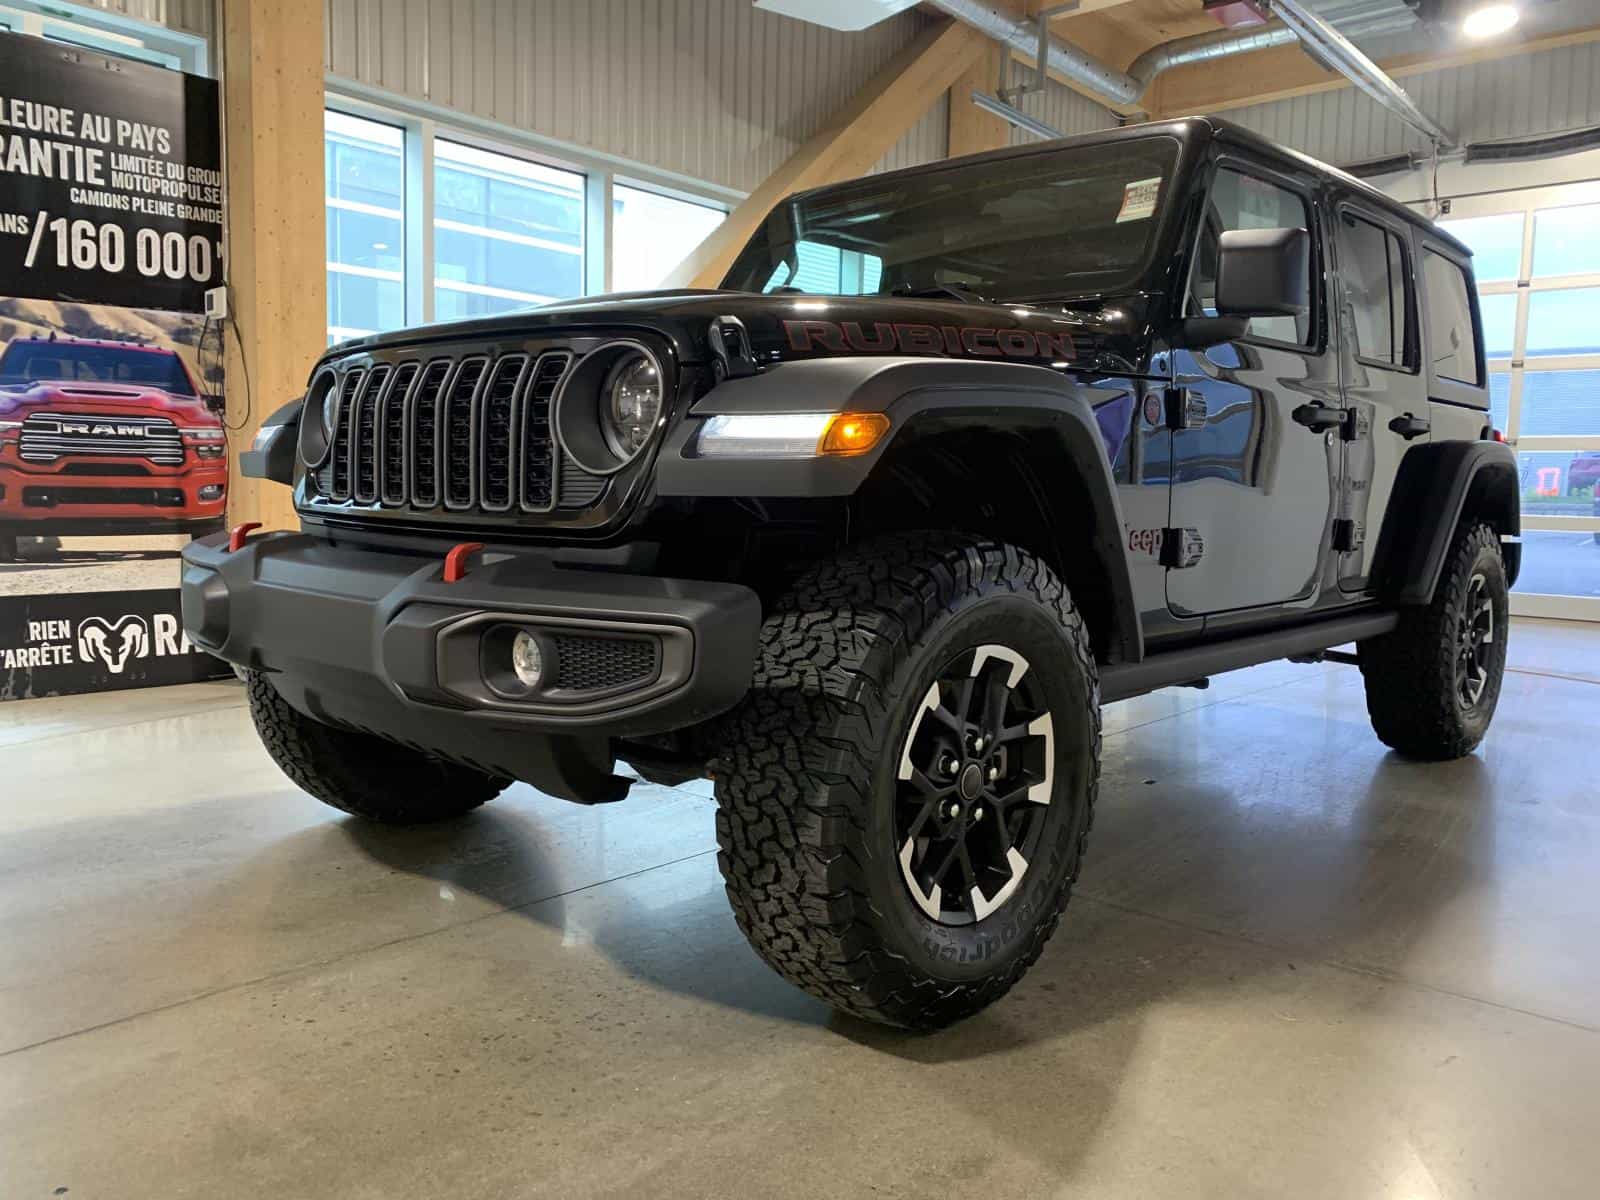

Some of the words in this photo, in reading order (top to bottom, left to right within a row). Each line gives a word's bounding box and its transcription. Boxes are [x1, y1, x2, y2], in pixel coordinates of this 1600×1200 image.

[80, 113, 111, 144] AU
[117, 120, 171, 155] PAYS
[0, 133, 105, 186] ANTIE
[110, 151, 164, 177] LIMITÉE
[166, 162, 185, 180] DU
[70, 187, 130, 211] CAMIONS
[132, 196, 175, 217] PLEINE
[136, 228, 212, 283] 000
[782, 319, 1078, 360] RUBICON
[63, 423, 144, 436] RAM
[1127, 526, 1162, 555] eep
[29, 619, 71, 641] RIEN
